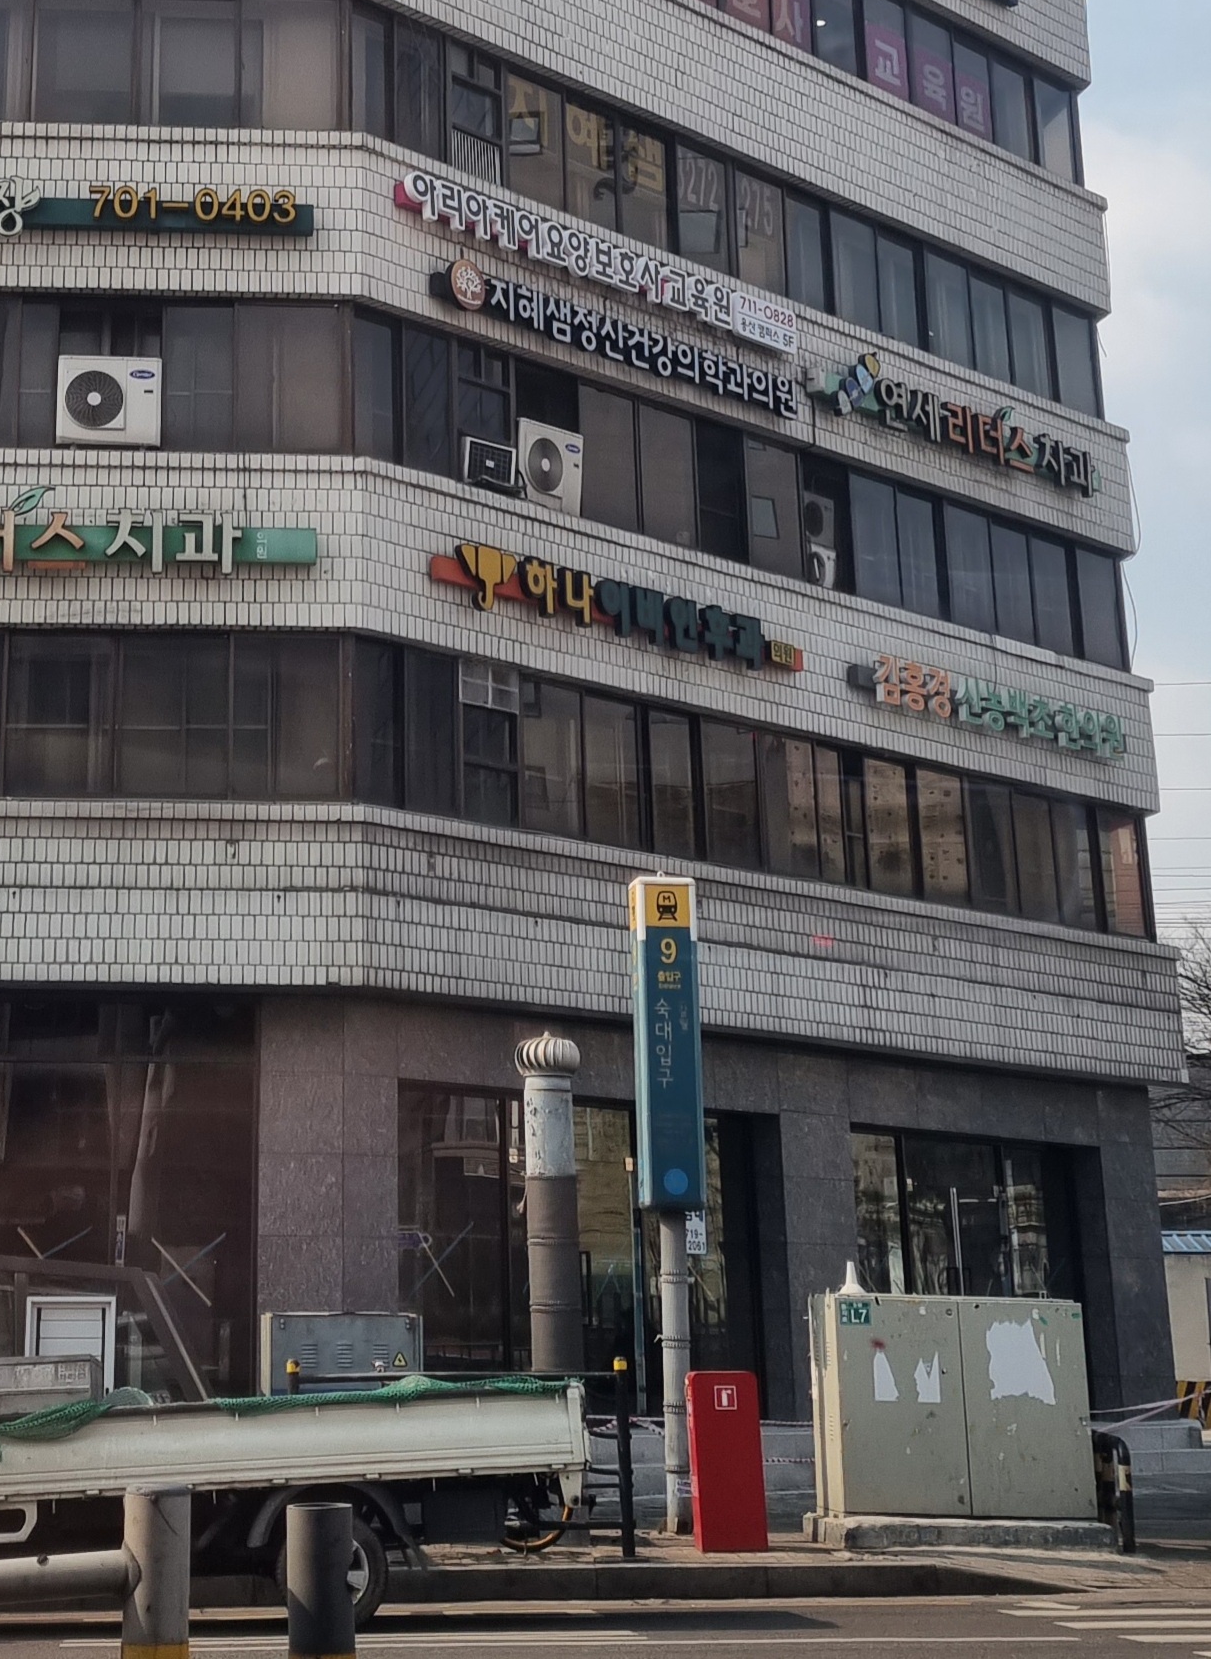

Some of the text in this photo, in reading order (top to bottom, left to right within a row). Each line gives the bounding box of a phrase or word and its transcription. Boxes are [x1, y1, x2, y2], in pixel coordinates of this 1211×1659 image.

[88, 184, 297, 225] 701-0403
[739, 295, 794, 329] 711-0828
[782, 333, 795, 348] 5F
[660, 938, 677, 964] 9
[653, 997, 674, 1090] 숙대입구
[851, 1309, 867, 1323] L7
